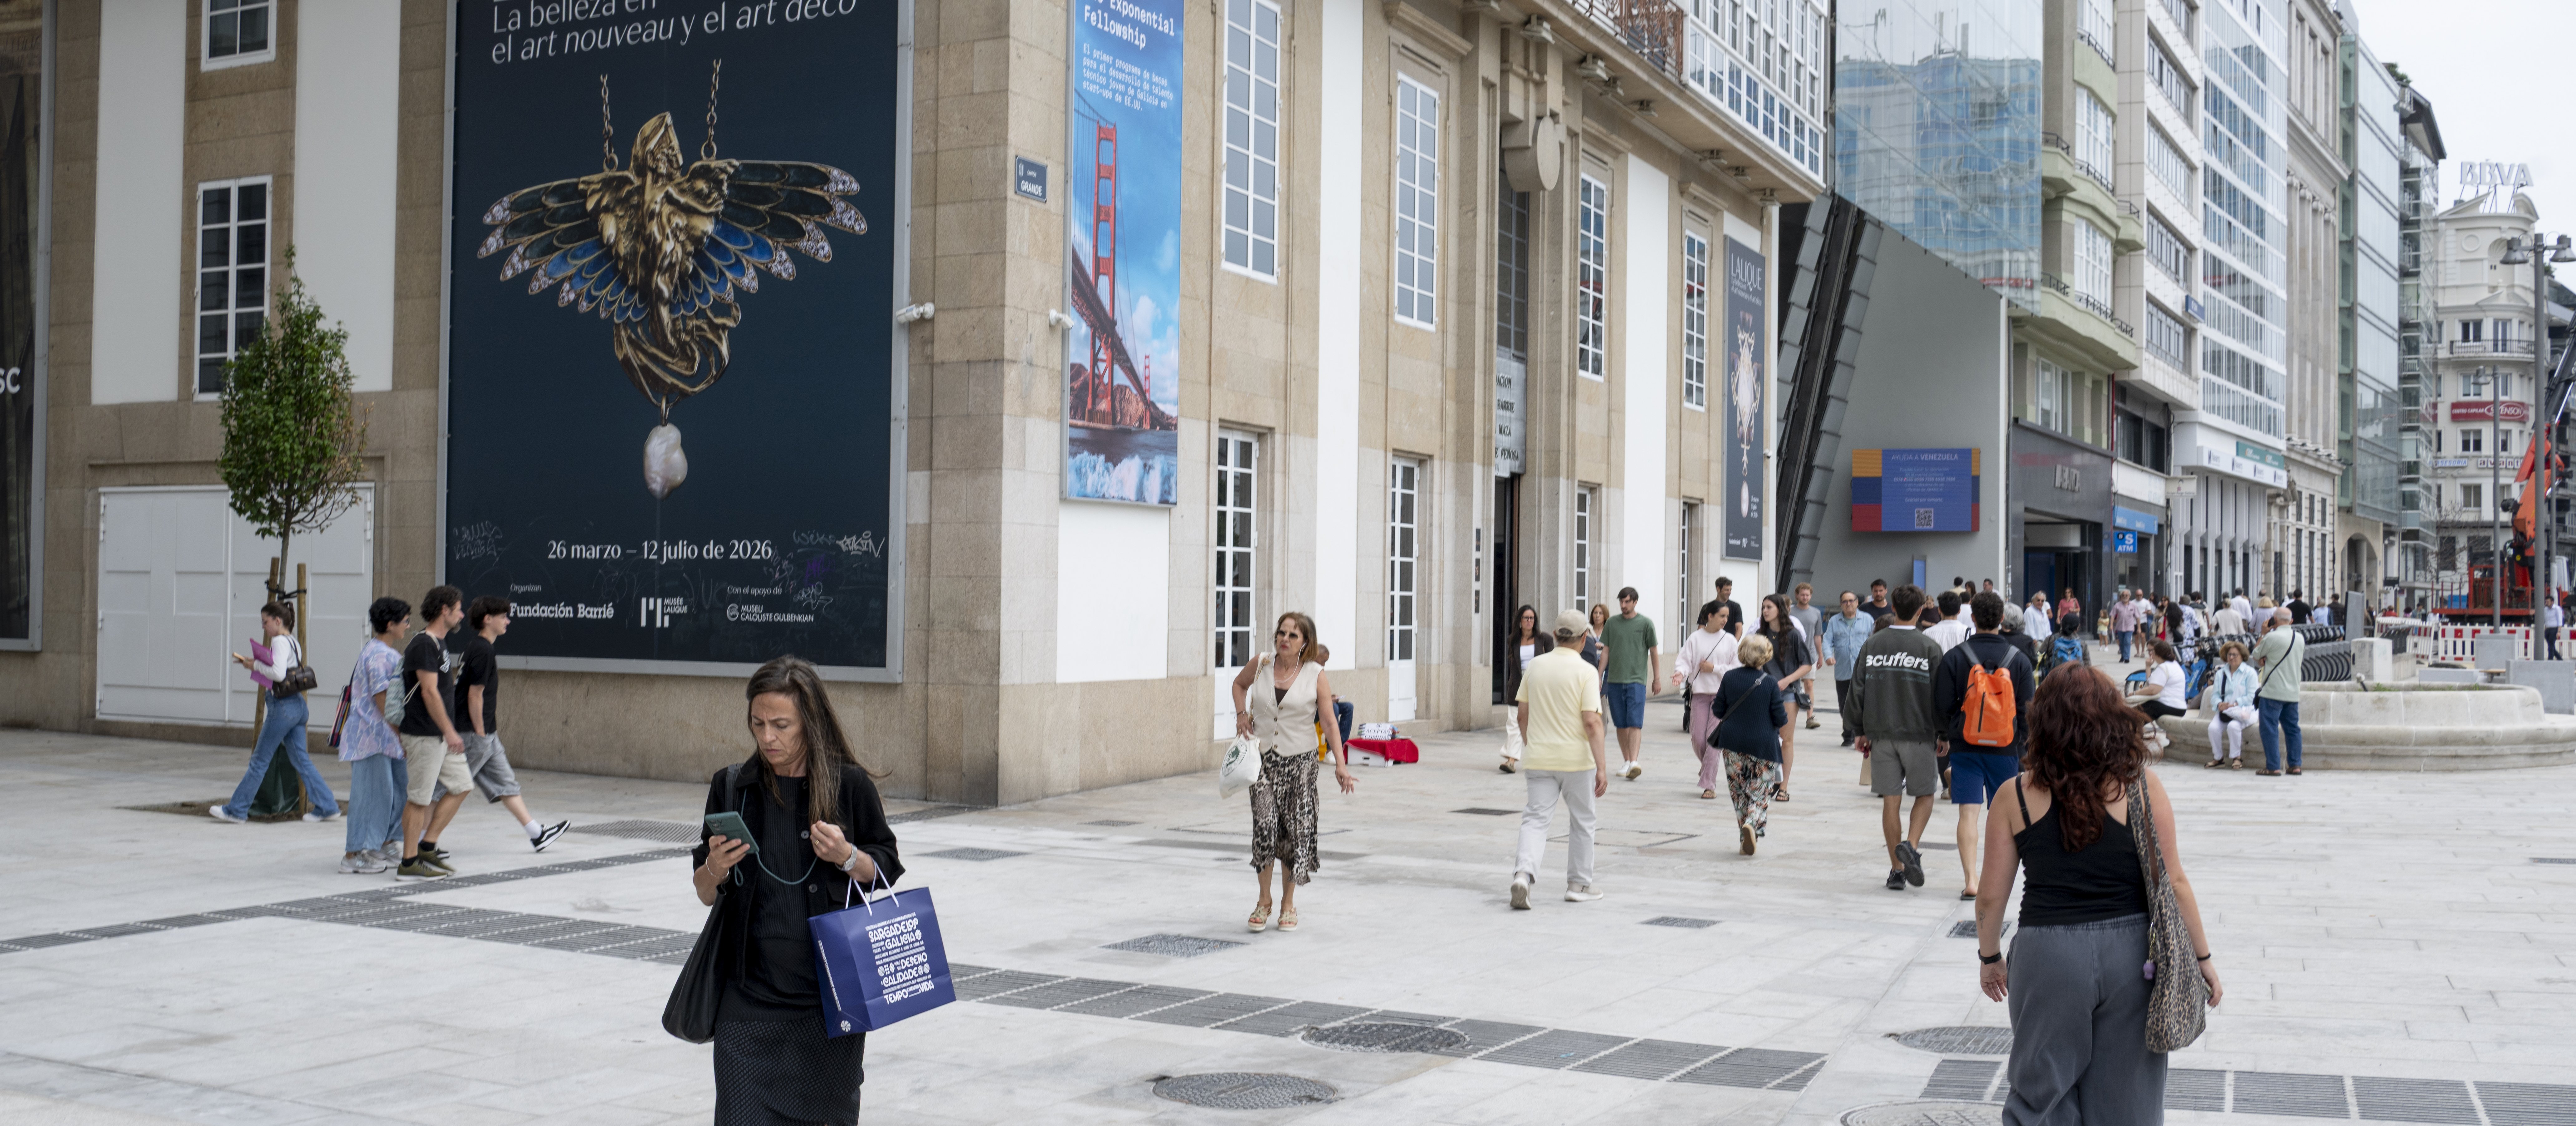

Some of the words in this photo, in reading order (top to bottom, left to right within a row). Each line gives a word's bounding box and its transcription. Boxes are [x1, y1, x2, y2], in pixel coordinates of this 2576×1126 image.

[494, 5, 521, 33] La
[530, 0, 616, 28] belleza
[1110, 0, 1175, 37] Exponential
[492, 34, 512, 64] el
[520, 30, 558, 60] art
[564, 17, 674, 54] nouveau
[680, 14, 695, 46] y
[703, 1, 725, 34] el
[736, 0, 778, 29] art
[1084, 4, 1146, 51] Fellowship
[1083, 43, 1090, 55] El
[1093, 49, 1113, 65] primer
[1115, 58, 1141, 76] programa
[1143, 68, 1150, 80] de
[1152, 71, 1168, 87] becas
[1083, 56, 1096, 70] para
[1099, 62, 1106, 74] el
[1109, 66, 1141, 88] desarrollo
[1143, 80, 1150, 91] de
[1152, 84, 1173, 101] talento
[1083, 67, 1106, 85] técnico
[1109, 77, 1125, 93] joven
[1127, 85, 1134, 97] de
[1137, 88, 1158, 106] Galicia
[1160, 100, 1167, 110] en
[1083, 80, 1112, 100] start-ups
[1115, 91, 1122, 104] de
[1125, 95, 1143, 112] EE.UU.
[2460, 161, 2534, 187] BBVA
[1021, 179, 1042, 197] GRANDE
[1731, 252, 1762, 292] LALIQUE
[1497, 398, 1515, 413] BARRIE
[2490, 406, 2522, 416] SENSON
[1499, 423, 1511, 437] MAZA
[2117, 544, 2134, 553] ATM
[2125, 533, 2134, 545] S
[547, 540, 567, 559] 26
[571, 544, 622, 559] marzo
[642, 540, 658, 559] 12
[660, 540, 698, 565] julio
[703, 539, 724, 559] de
[729, 539, 773, 560] 2026
[510, 583, 542, 594] Organizan
[727, 585, 742, 595] Con
[743, 585, 749, 594] el
[750, 587, 772, 597] apoyo
[773, 585, 782, 595] de
[509, 602, 573, 618] Fundación
[577, 602, 614, 619] Barrié
[664, 596, 684, 606] MUSÉE
[664, 605, 688, 614] LALIQUE
[741, 604, 763, 614] MUSEU
[740, 612, 773, 622] CALOUSTE
[773, 613, 814, 623] GULBENKIAN
[1866, 651, 1929, 671] scuffers
[868, 917, 919, 943] SARGADELOS
[885, 931, 916, 949] GALICIA
[875, 951, 888, 960] UTILIZANDO
[883, 967, 919, 987] CALIDADE
[884, 988, 908, 1005] TEMPO
[919, 980, 934, 993] VIDA
